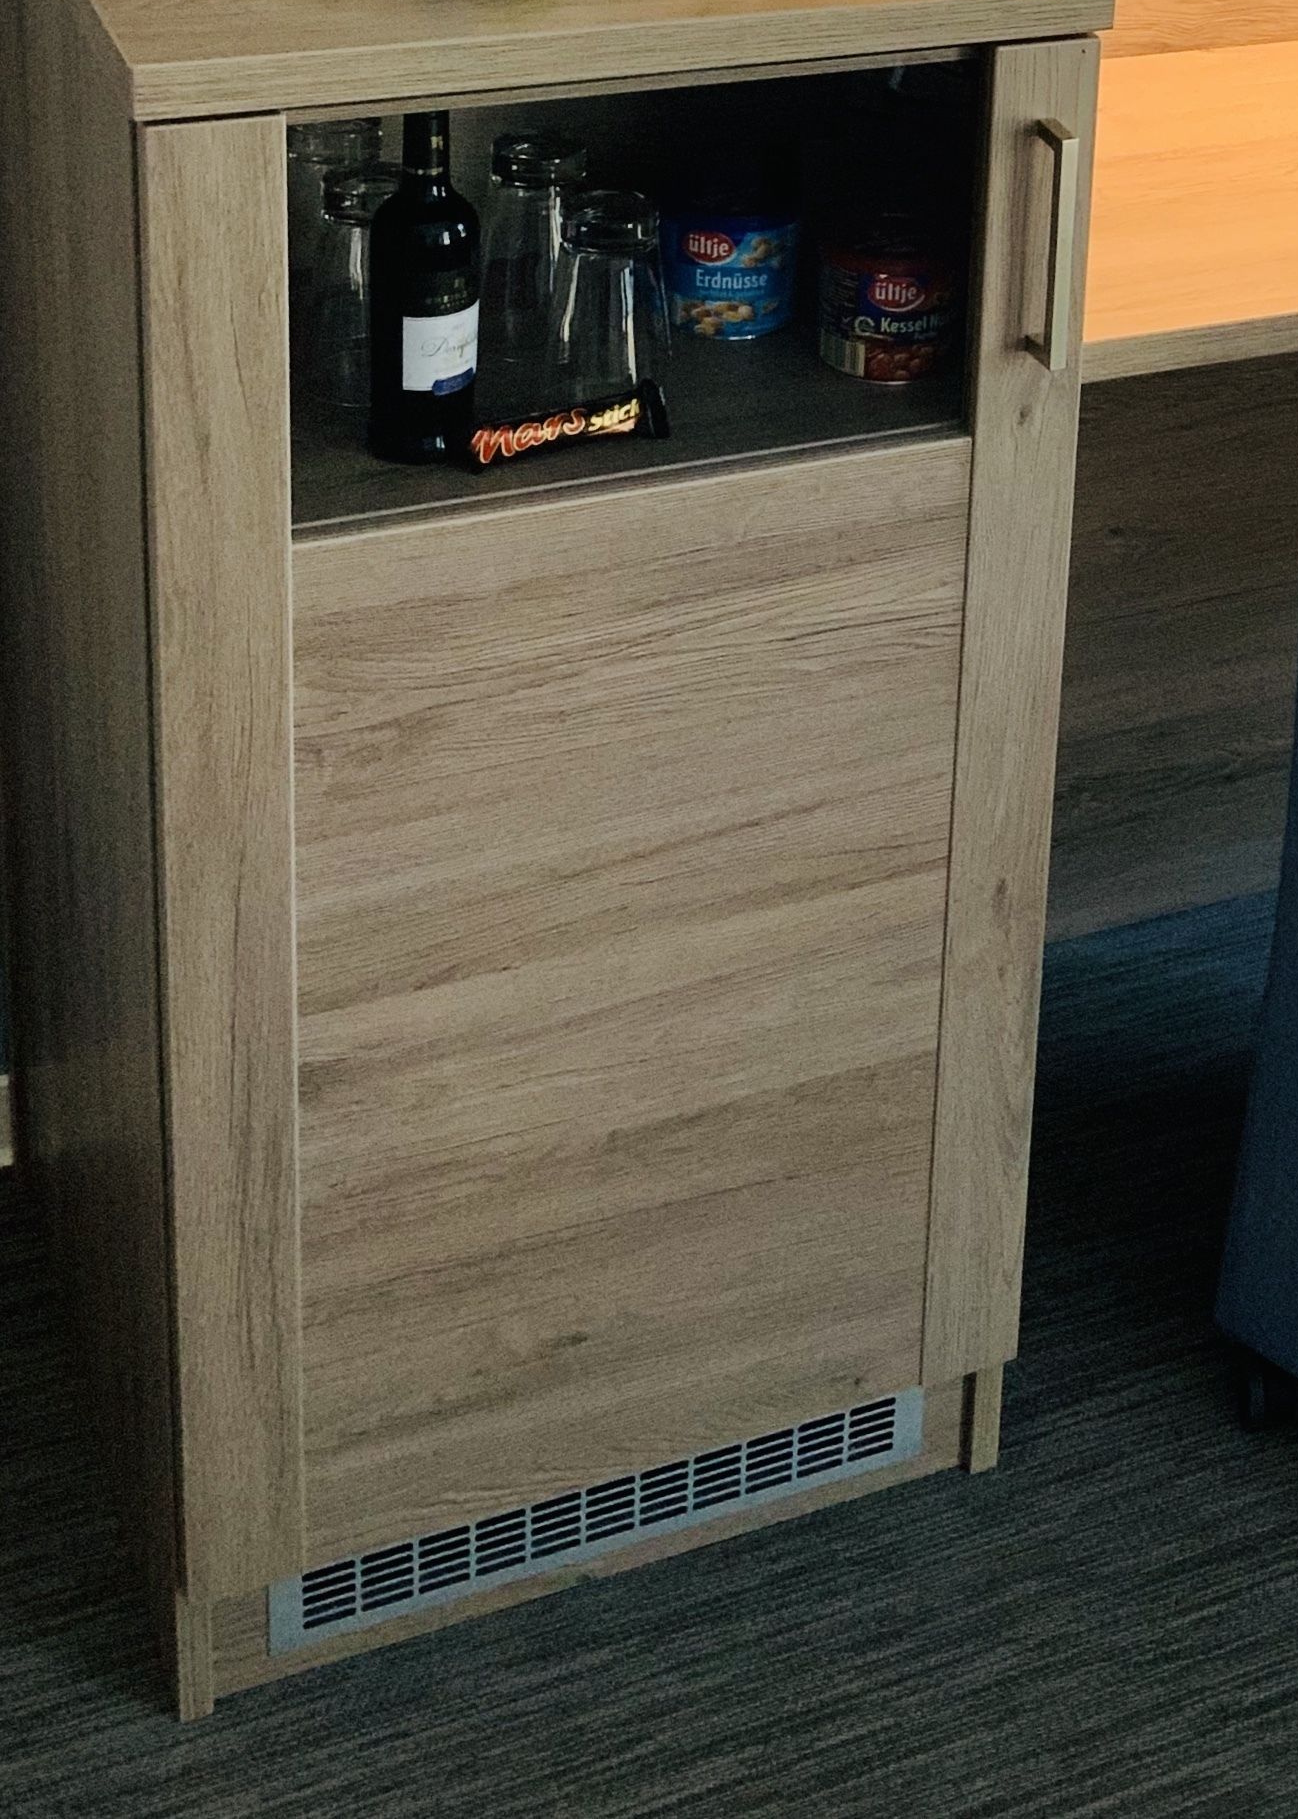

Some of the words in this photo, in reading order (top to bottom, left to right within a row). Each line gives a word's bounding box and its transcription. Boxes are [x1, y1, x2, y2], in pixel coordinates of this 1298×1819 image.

[688, 233, 730, 259] ültje
[696, 268, 768, 290] Erdnüsse
[875, 282, 917, 304] ültje
[880, 315, 927, 334] Kessel
